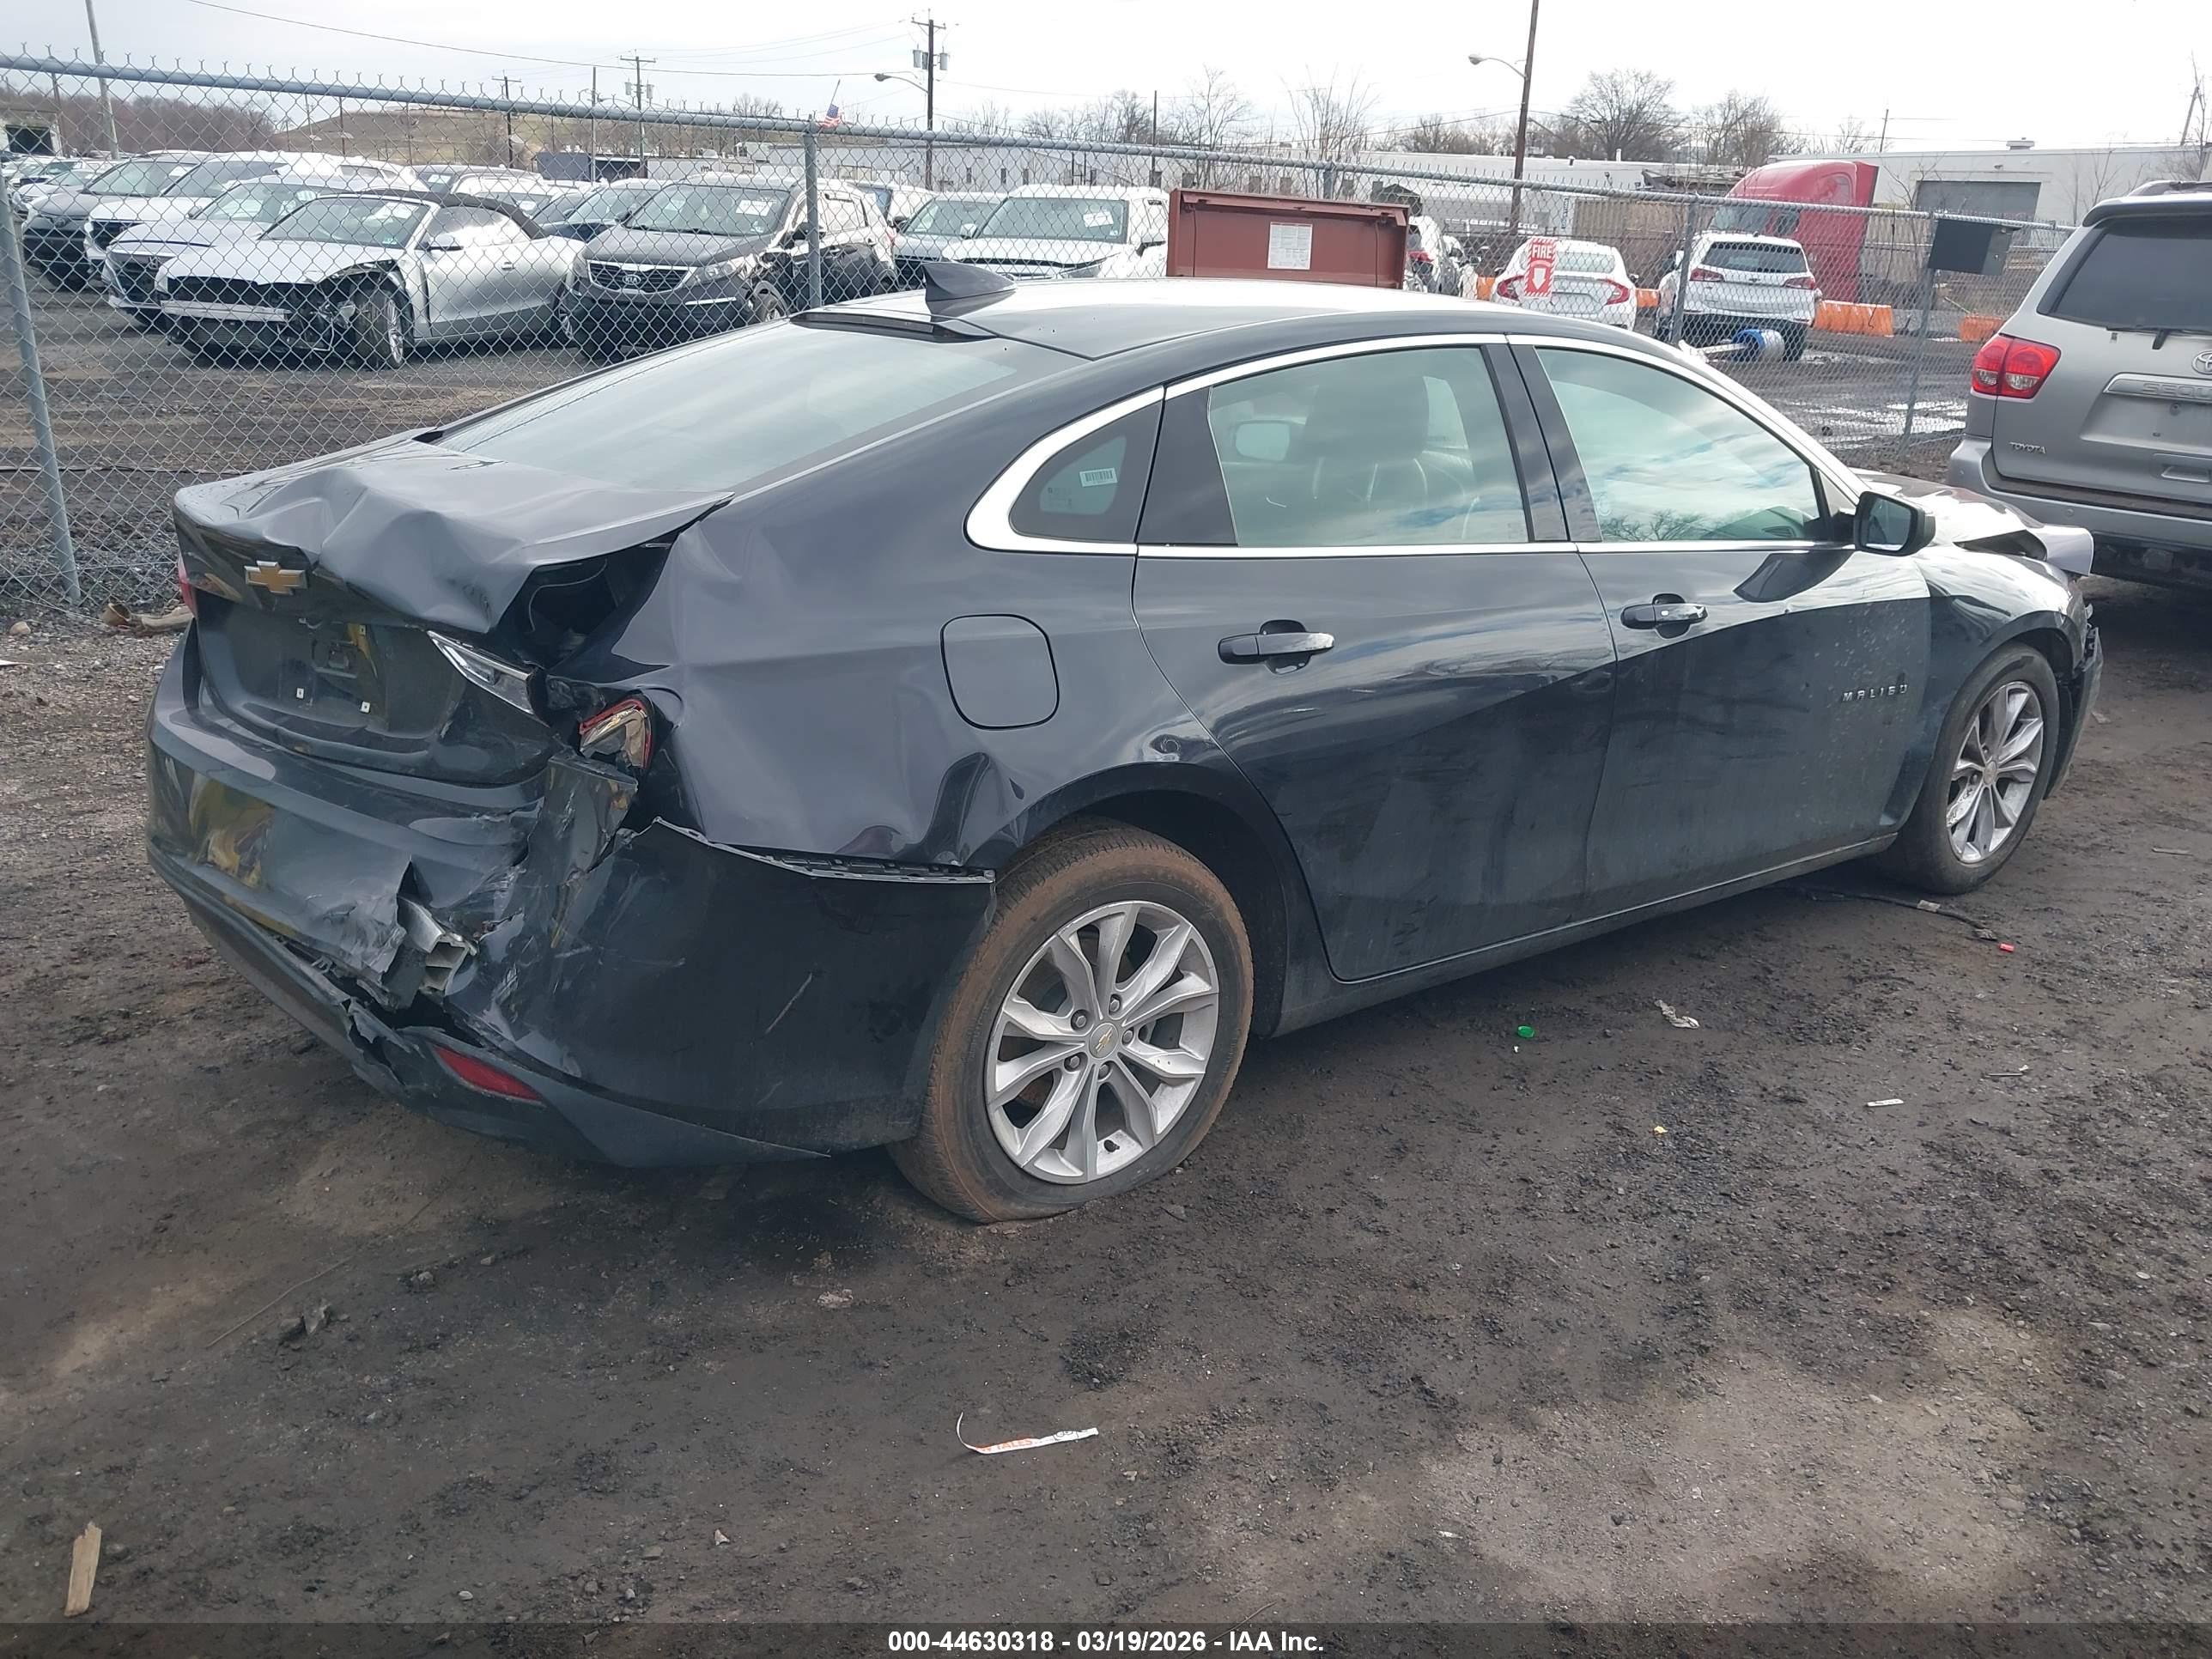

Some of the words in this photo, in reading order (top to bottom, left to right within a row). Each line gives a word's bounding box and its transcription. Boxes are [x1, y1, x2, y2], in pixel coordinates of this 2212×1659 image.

[1531, 244, 1553, 259] FIRE
[624, 276, 639, 284] KIA
[2008, 441, 2046, 454] TOYOTA
[1842, 684, 1908, 702] MALIBU
